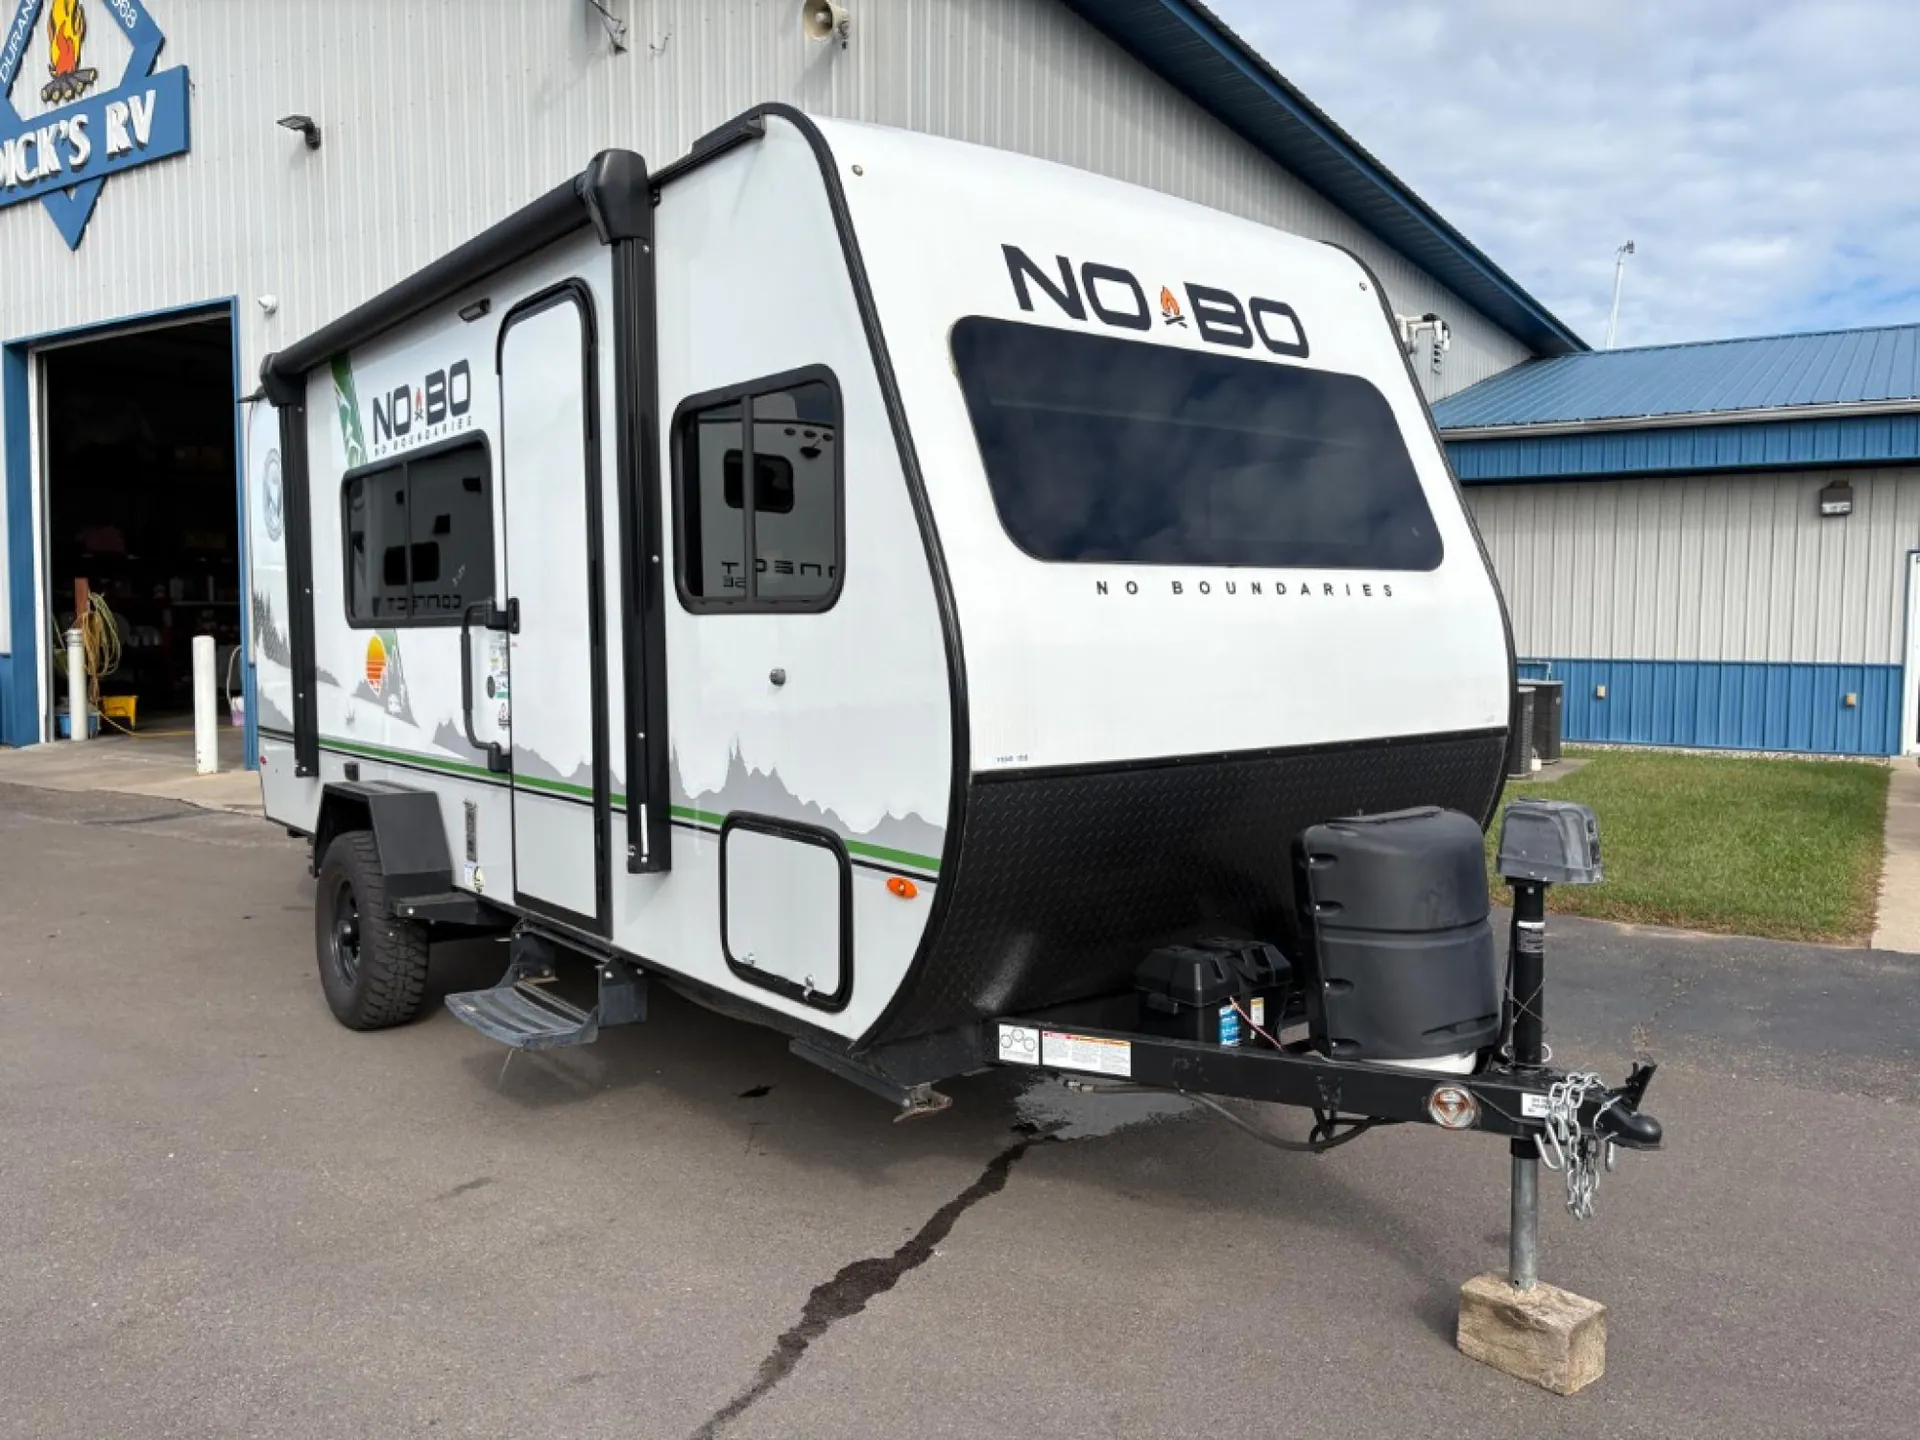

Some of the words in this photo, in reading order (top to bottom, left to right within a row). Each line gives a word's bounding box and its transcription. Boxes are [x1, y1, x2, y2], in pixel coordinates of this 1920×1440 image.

[105, 90, 156, 154] RV
[1096, 580, 1138, 595] NO
[1172, 580, 1393, 597] BOUNDARIES
